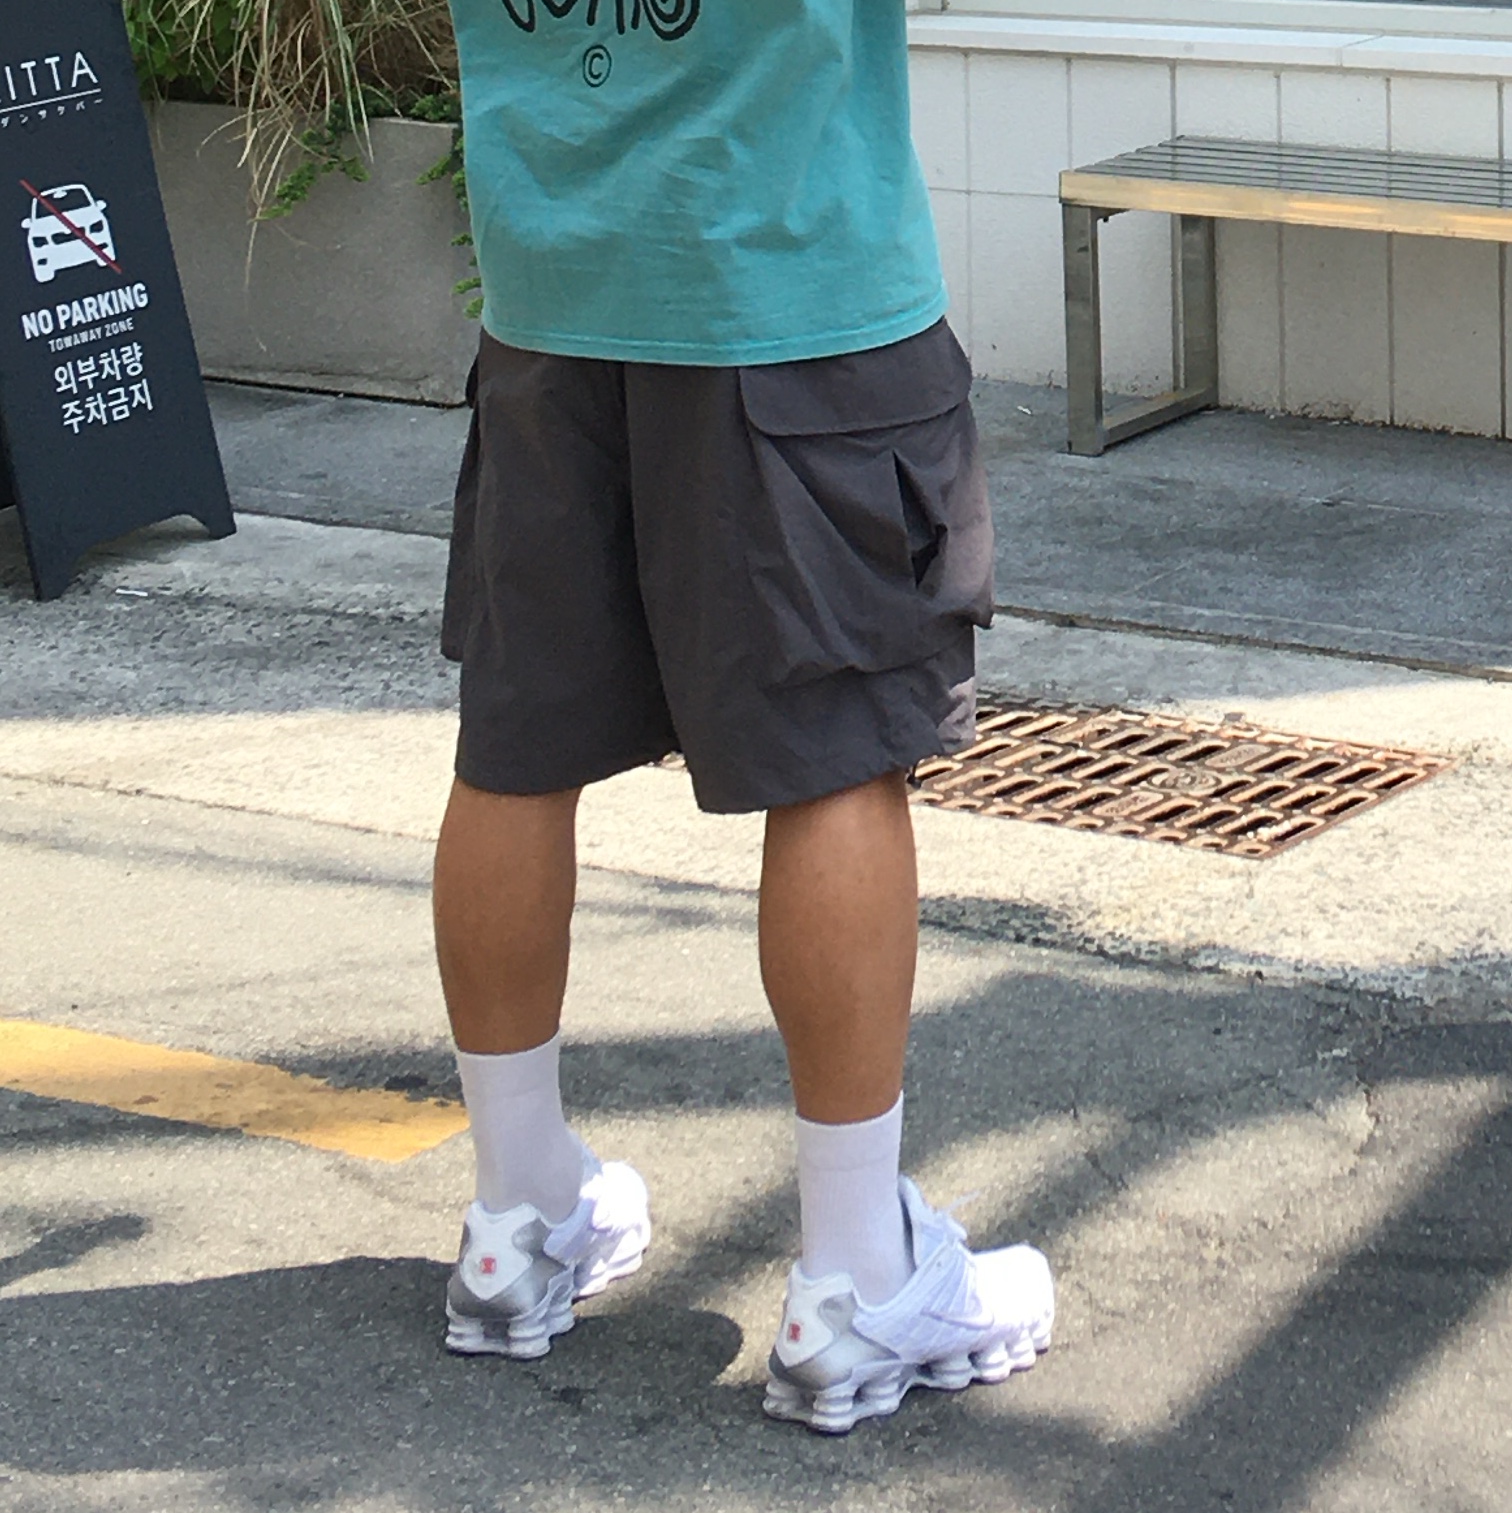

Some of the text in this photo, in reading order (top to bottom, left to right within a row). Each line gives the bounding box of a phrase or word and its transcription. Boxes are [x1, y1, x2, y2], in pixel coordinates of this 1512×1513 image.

[0, 51, 99, 103] ITTA
[21, 282, 149, 340] NO PARKING
[48, 317, 134, 353] TOWAWAY ZONE
[54, 341, 143, 395] 외부차량
[61, 378, 154, 434] 주차금지
